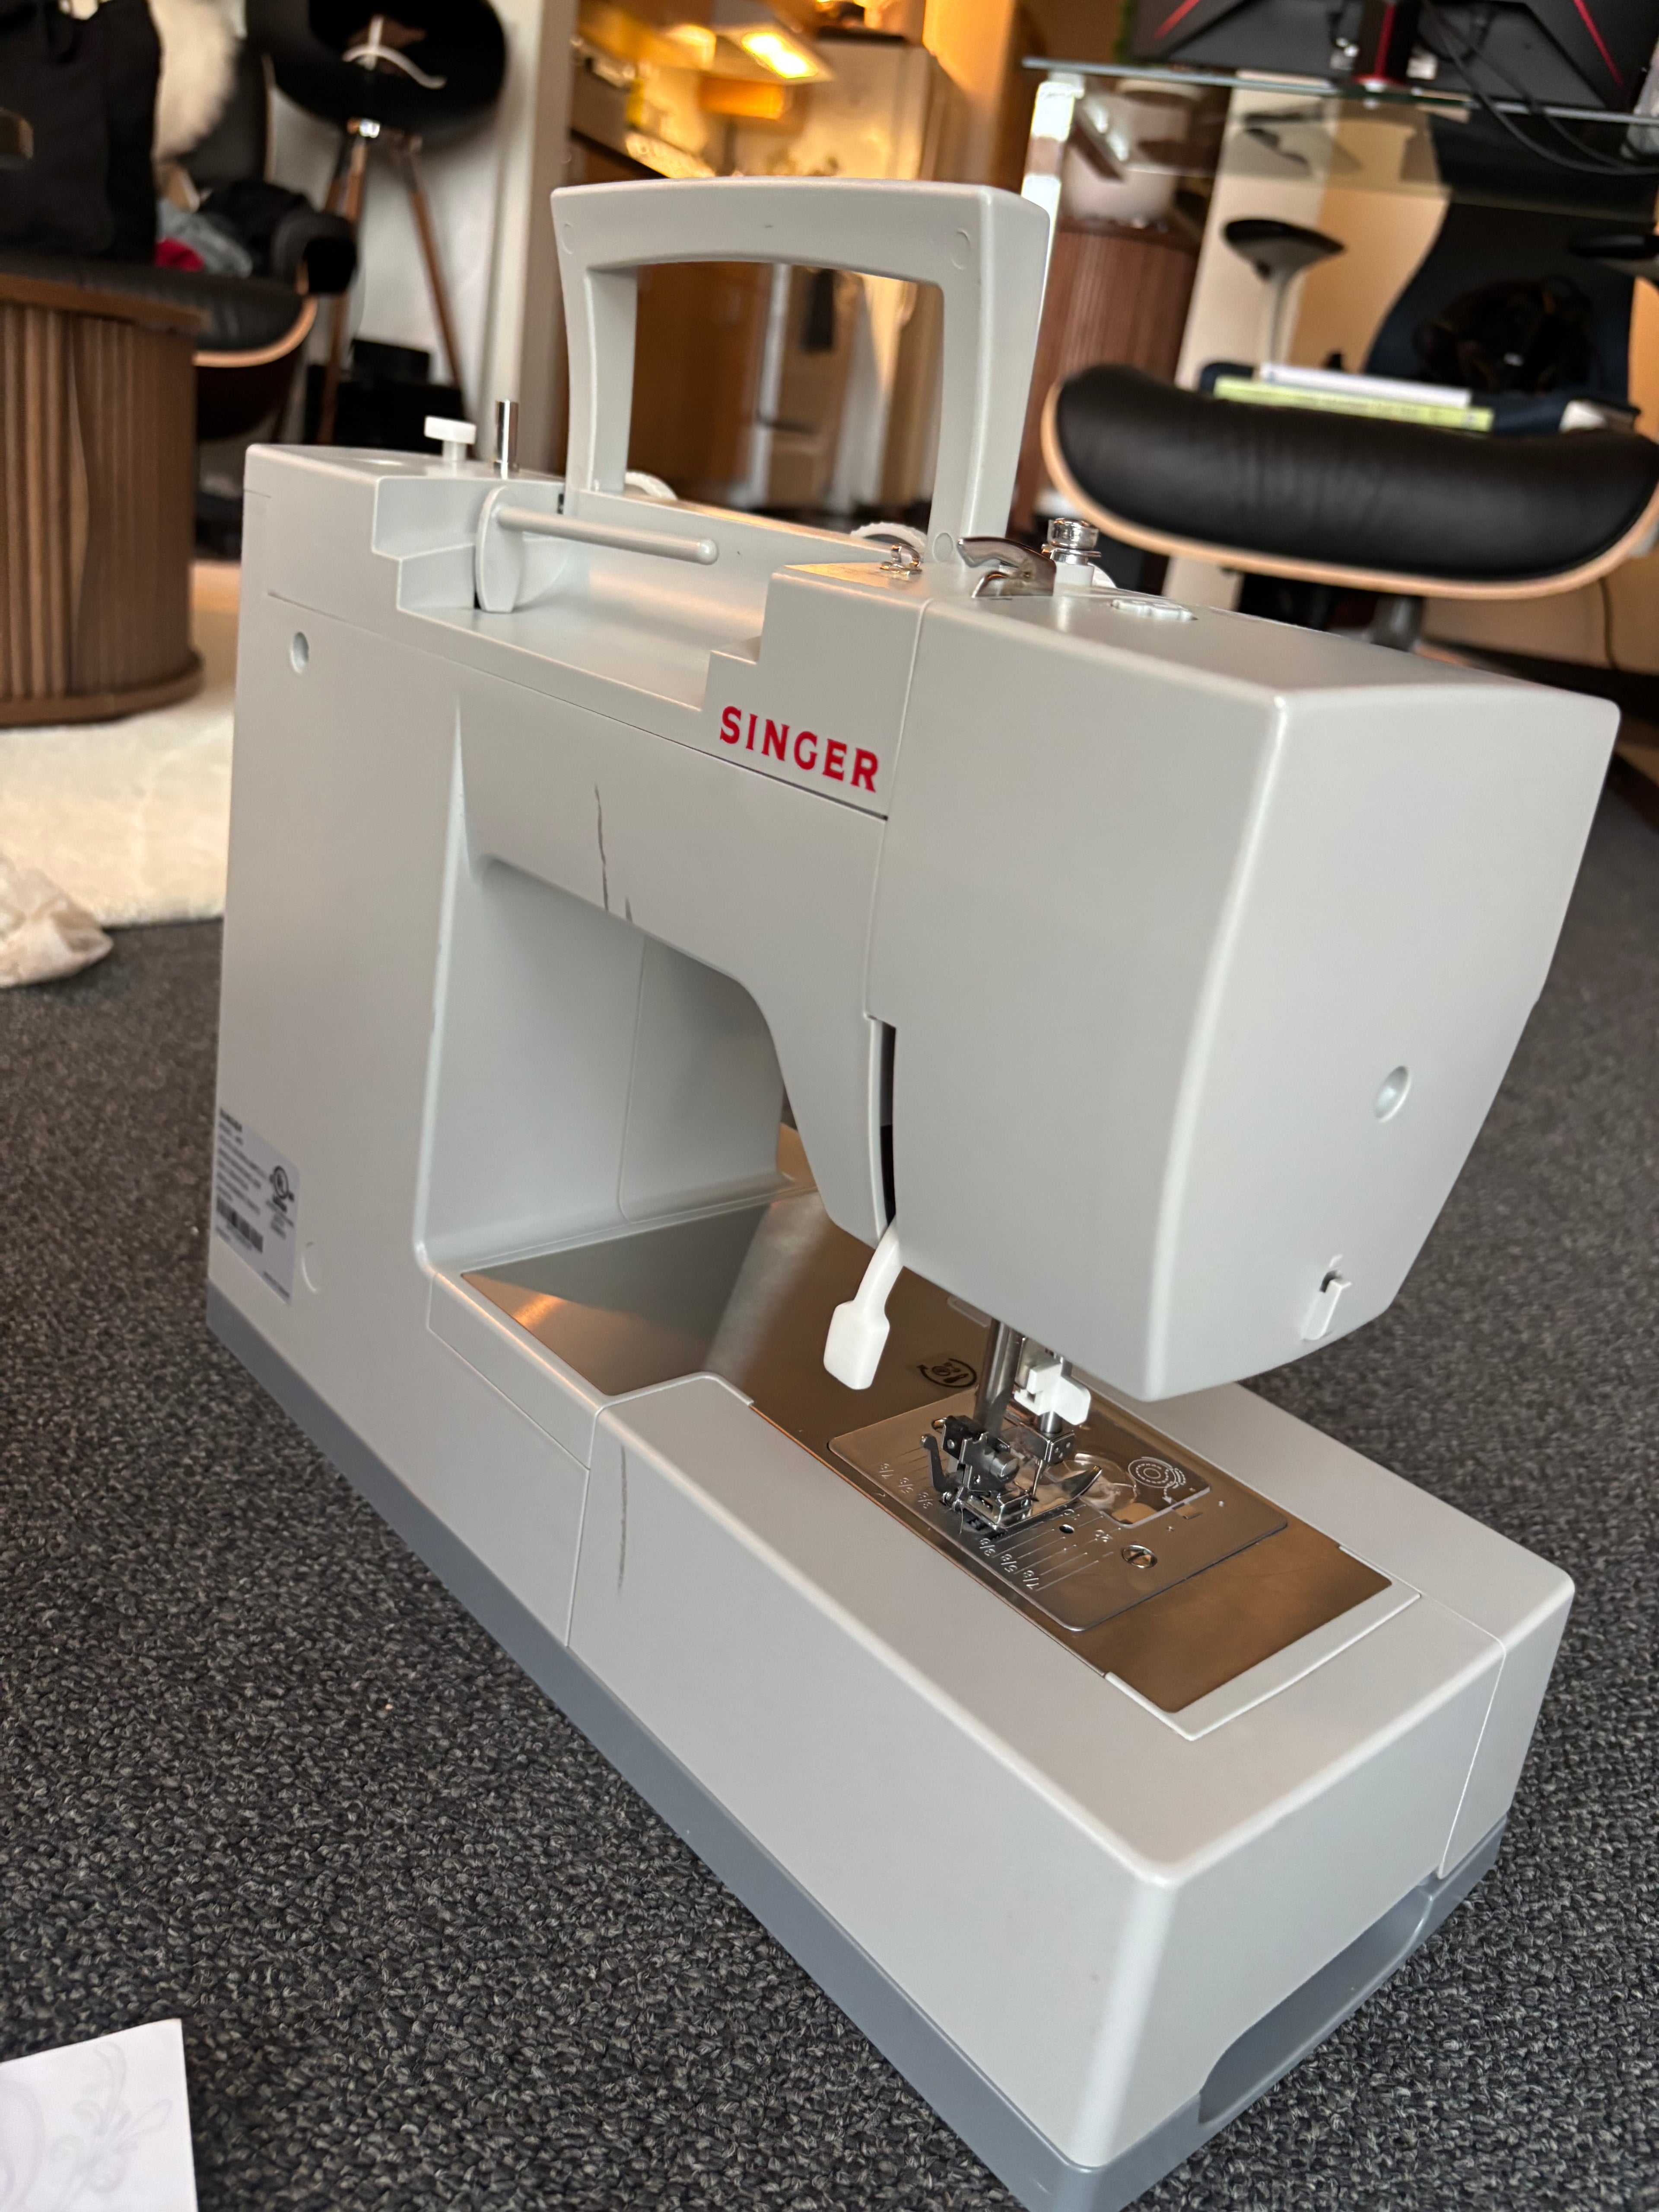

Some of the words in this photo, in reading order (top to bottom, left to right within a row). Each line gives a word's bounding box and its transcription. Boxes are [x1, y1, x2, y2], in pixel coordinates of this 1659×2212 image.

[719, 706, 879, 793] SINGER
[979, 1538, 996, 1556] 3/8
[1000, 1554, 1018, 1573] 5/8
[1022, 1570, 1039, 1590] 7/8
